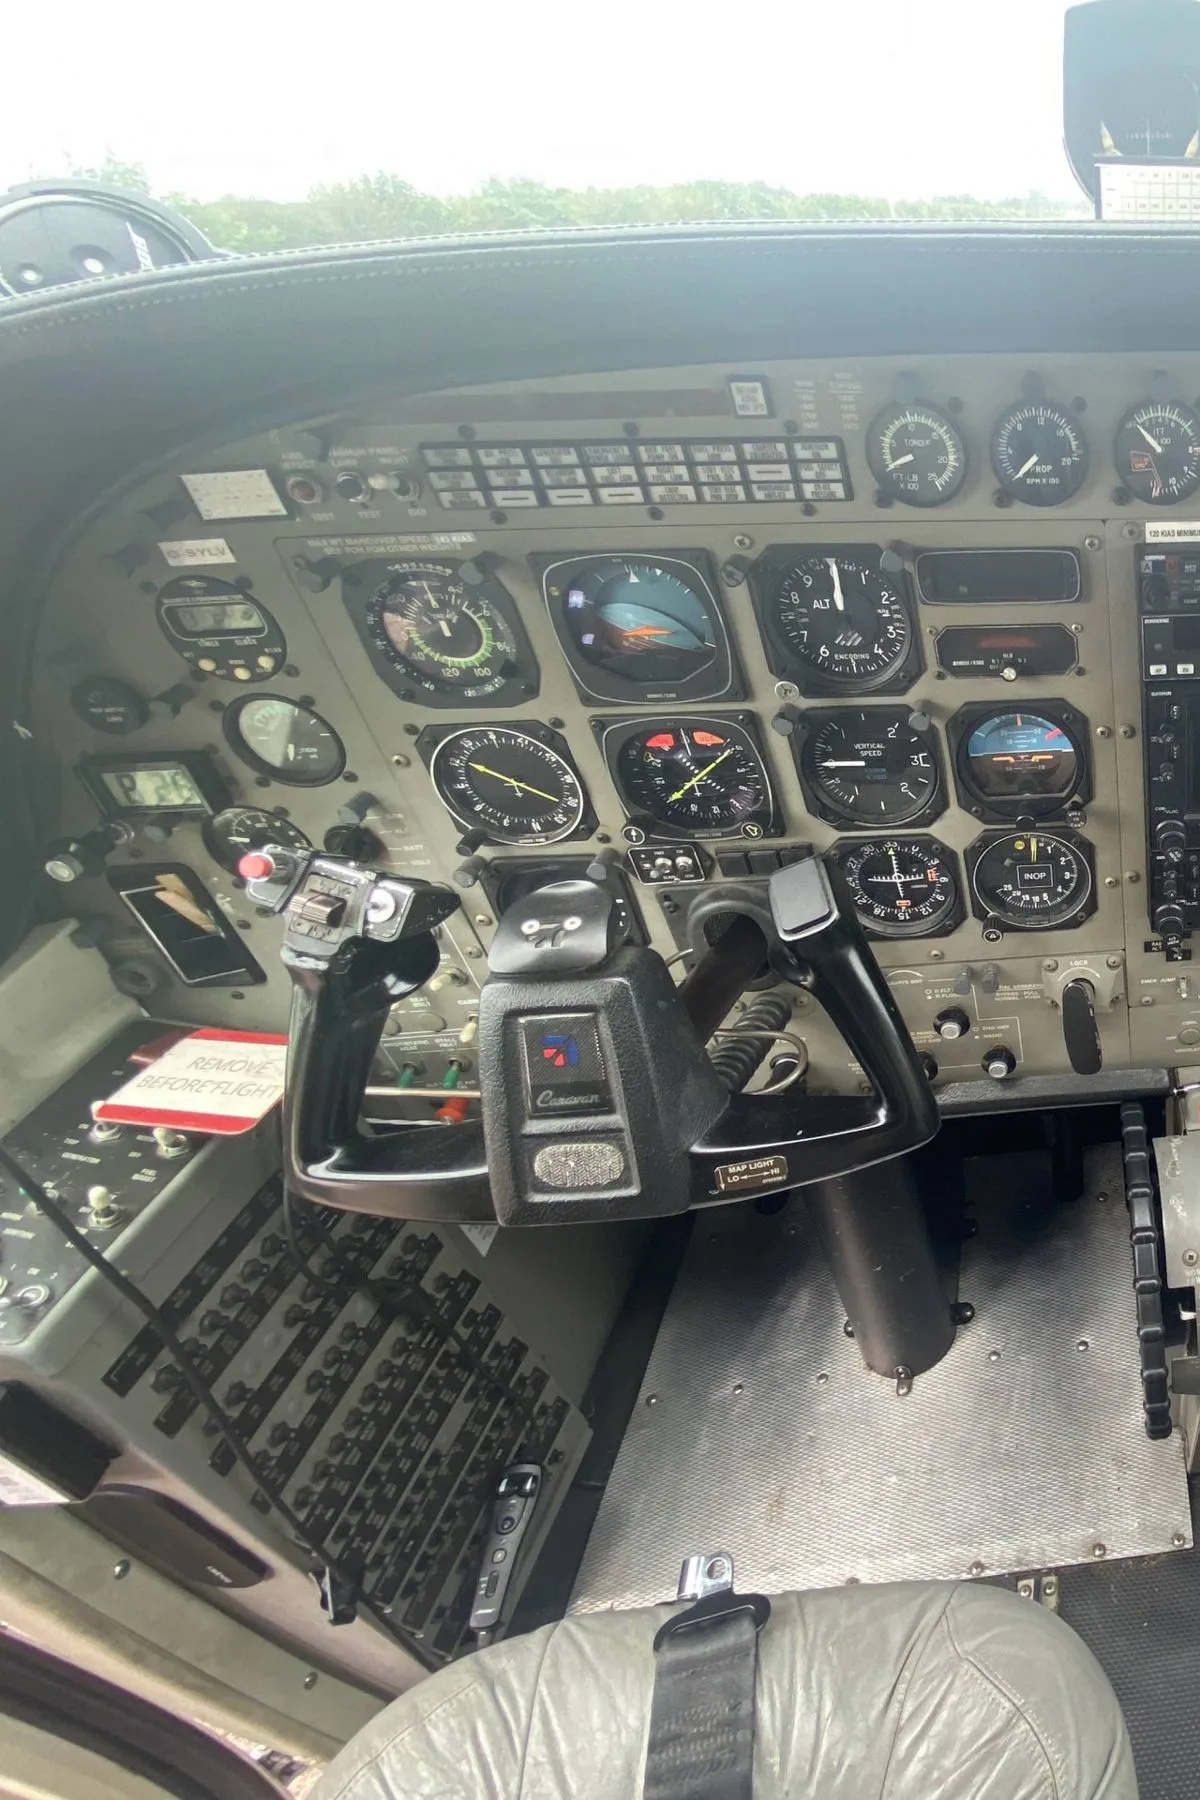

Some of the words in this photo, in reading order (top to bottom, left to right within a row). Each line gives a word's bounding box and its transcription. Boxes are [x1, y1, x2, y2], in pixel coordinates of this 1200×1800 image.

[1061, 457, 1072, 466] 20
[803, 575, 813, 588] 9
[790, 592, 800, 604] 8
[881, 591, 890, 604] 2
[813, 599, 831, 609] ALT
[887, 626, 896, 638] 3
[820, 644, 830, 657] 6
[874, 643, 883, 655] 4
[887, 727, 897, 739] 2
[910, 755, 920, 766] 3
[900, 782, 909, 792] 2
[861, 844, 875, 855] 30
[1046, 846, 1052, 854] 1
[847, 857, 858, 869] 27
[930, 857, 940, 865] 3
[1059, 857, 1066, 865] 2
[1023, 872, 1047, 880] INOP
[1064, 871, 1070, 879] 3
[1056, 885, 1063, 893] 4
[873, 907, 886, 917] 18
[897, 912, 910, 920] 15
[920, 906, 933, 916] 12
[187, 1054, 270, 1076] REMOVE
[136, 1074, 212, 1096] BEFORE
[211, 1078, 286, 1100] FLIGHT
[536, 1088, 600, 1108] Caravan
[728, 1162, 747, 1174] MAP
[748, 1159, 775, 1171] LIGHT
[770, 1167, 780, 1175] HI
[727, 1175, 741, 1184] LO
